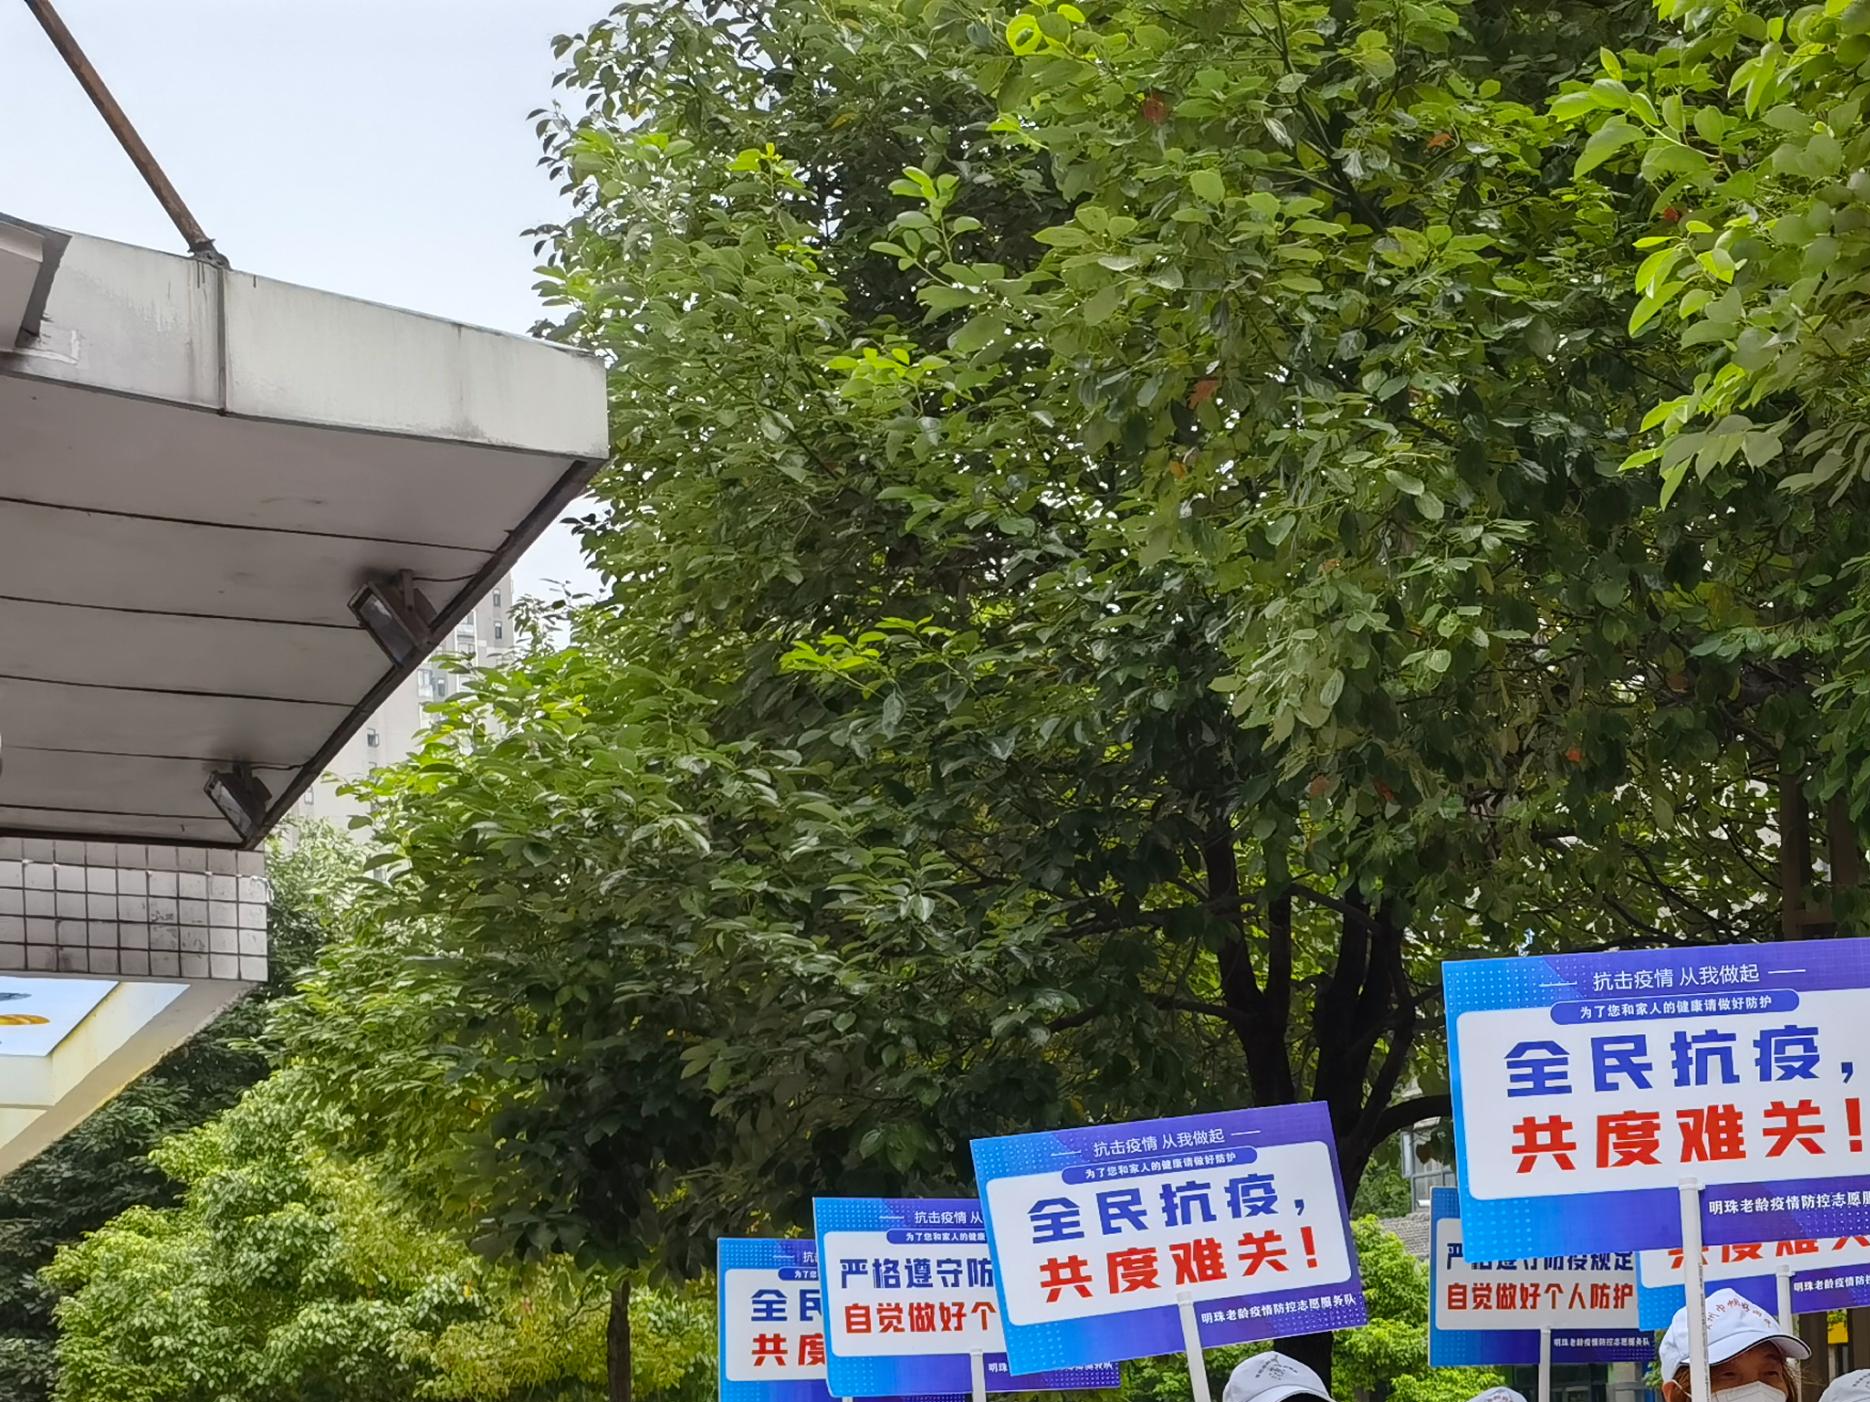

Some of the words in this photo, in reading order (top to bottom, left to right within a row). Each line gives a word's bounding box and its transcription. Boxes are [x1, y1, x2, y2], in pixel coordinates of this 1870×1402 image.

[1592, 969, 1674, 993] 抗击疫情
[1678, 963, 1761, 987] 从我做起
[1579, 995, 1773, 1020] 为了您和家人的健康请做好防护
[1093, 1135, 1158, 1158] 抗击疫情
[1161, 1127, 1226, 1151] 从我做起
[1511, 1097, 1864, 1175] 共度难关！
[1085, 1152, 1237, 1180] 为了您和家人的健康请做好防护
[914, 1211, 967, 1225] 抗击疫情
[1039, 1226, 1318, 1304] 共度难关！
[1201, 1293, 1357, 1324] 明珠老龄疫情防控志愿服务队
[1447, 1282, 1634, 1310] 自觉做好个人防护
[844, 1301, 997, 1334] 自觉做好个
